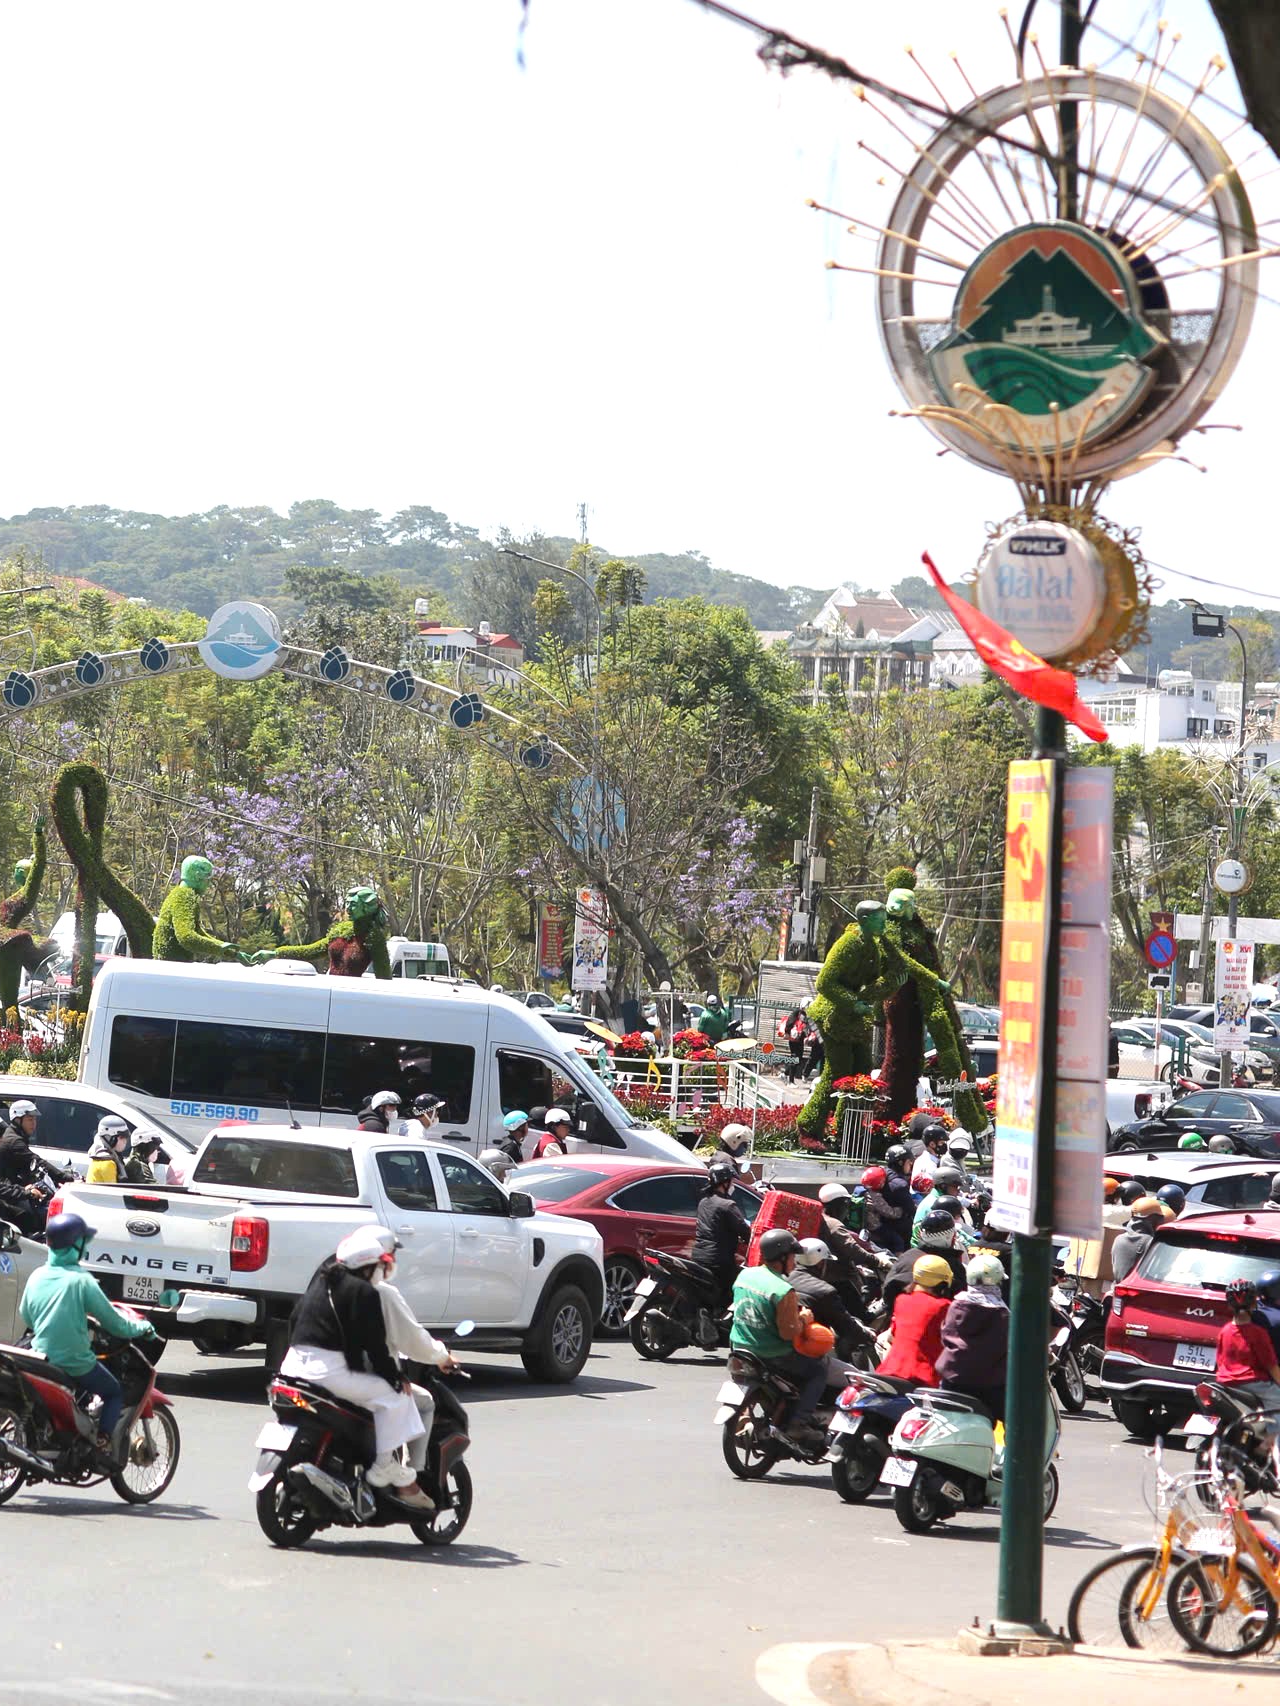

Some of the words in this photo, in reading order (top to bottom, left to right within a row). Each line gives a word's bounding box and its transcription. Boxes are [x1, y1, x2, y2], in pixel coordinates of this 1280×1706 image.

[170, 1101, 259, 1122] 50E-589.90
[135, 1277, 153, 1289] 49A
[127, 1287, 160, 1300] 942.66
